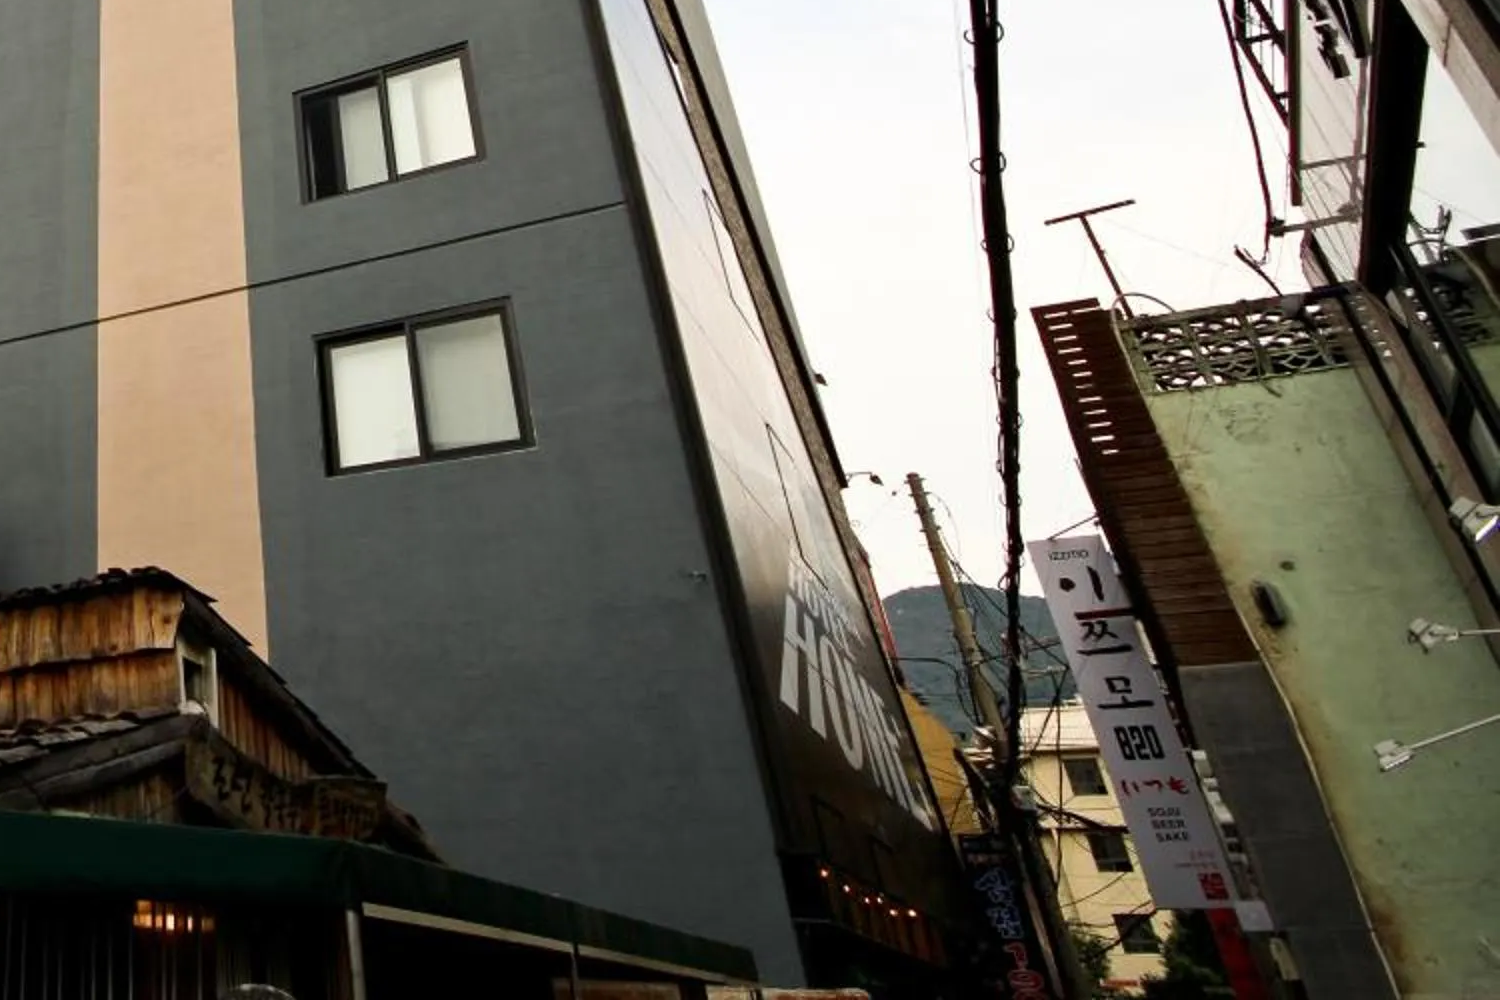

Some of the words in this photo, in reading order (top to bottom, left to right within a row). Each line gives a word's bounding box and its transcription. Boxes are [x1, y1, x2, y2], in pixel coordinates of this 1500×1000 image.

[1059, 566, 1155, 710] 이쯔모
[1113, 725, 1165, 760] 820
[1121, 776, 1190, 797] いつも
[1152, 819, 1187, 830] BEER
[1155, 831, 1192, 843] SAKE
